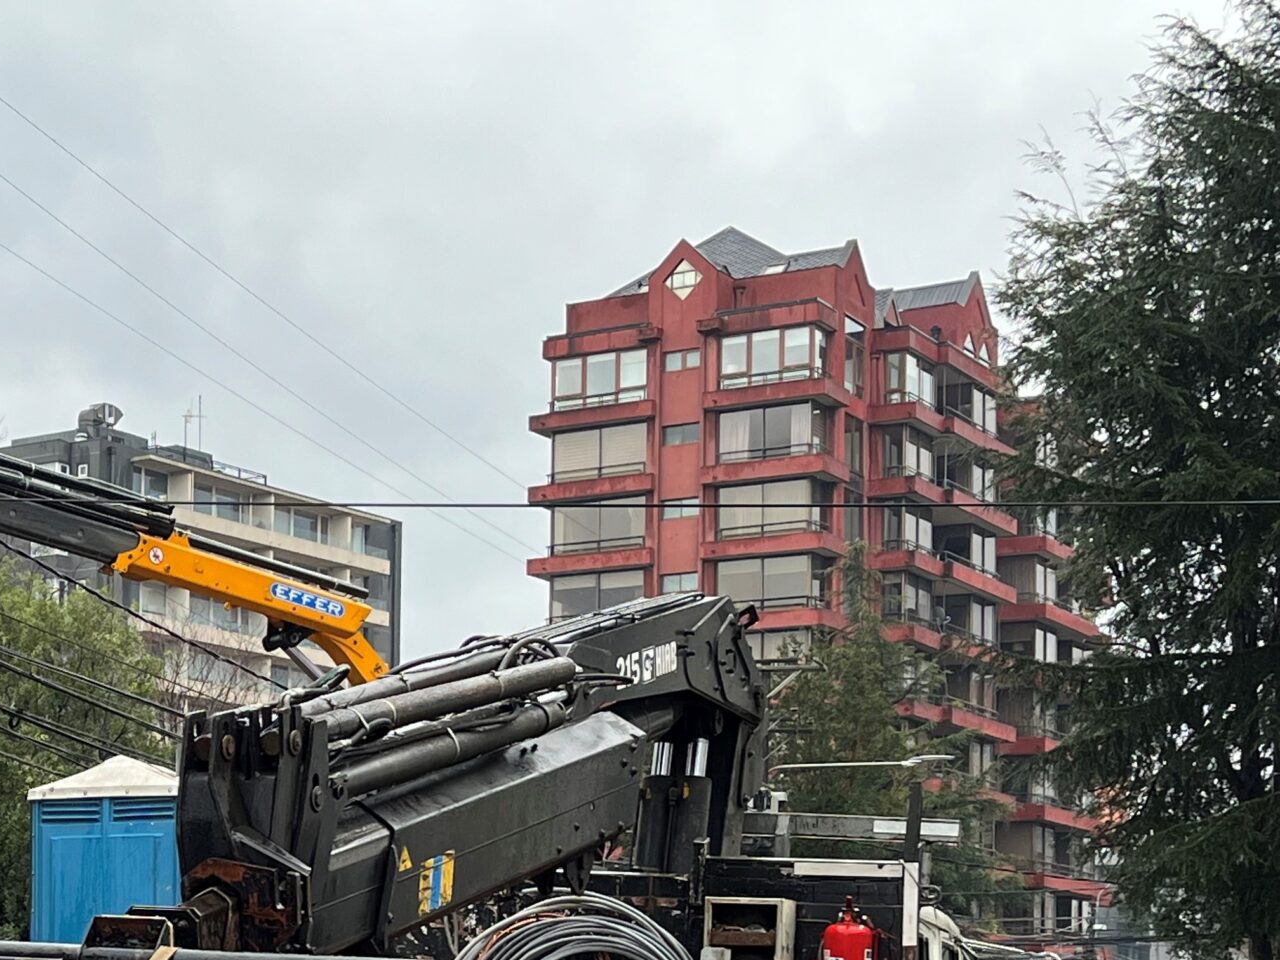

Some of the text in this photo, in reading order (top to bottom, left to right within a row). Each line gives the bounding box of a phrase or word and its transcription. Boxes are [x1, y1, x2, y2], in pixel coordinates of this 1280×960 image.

[275, 584, 341, 617] EFFER
[616, 641, 677, 690] 215 HIAB
